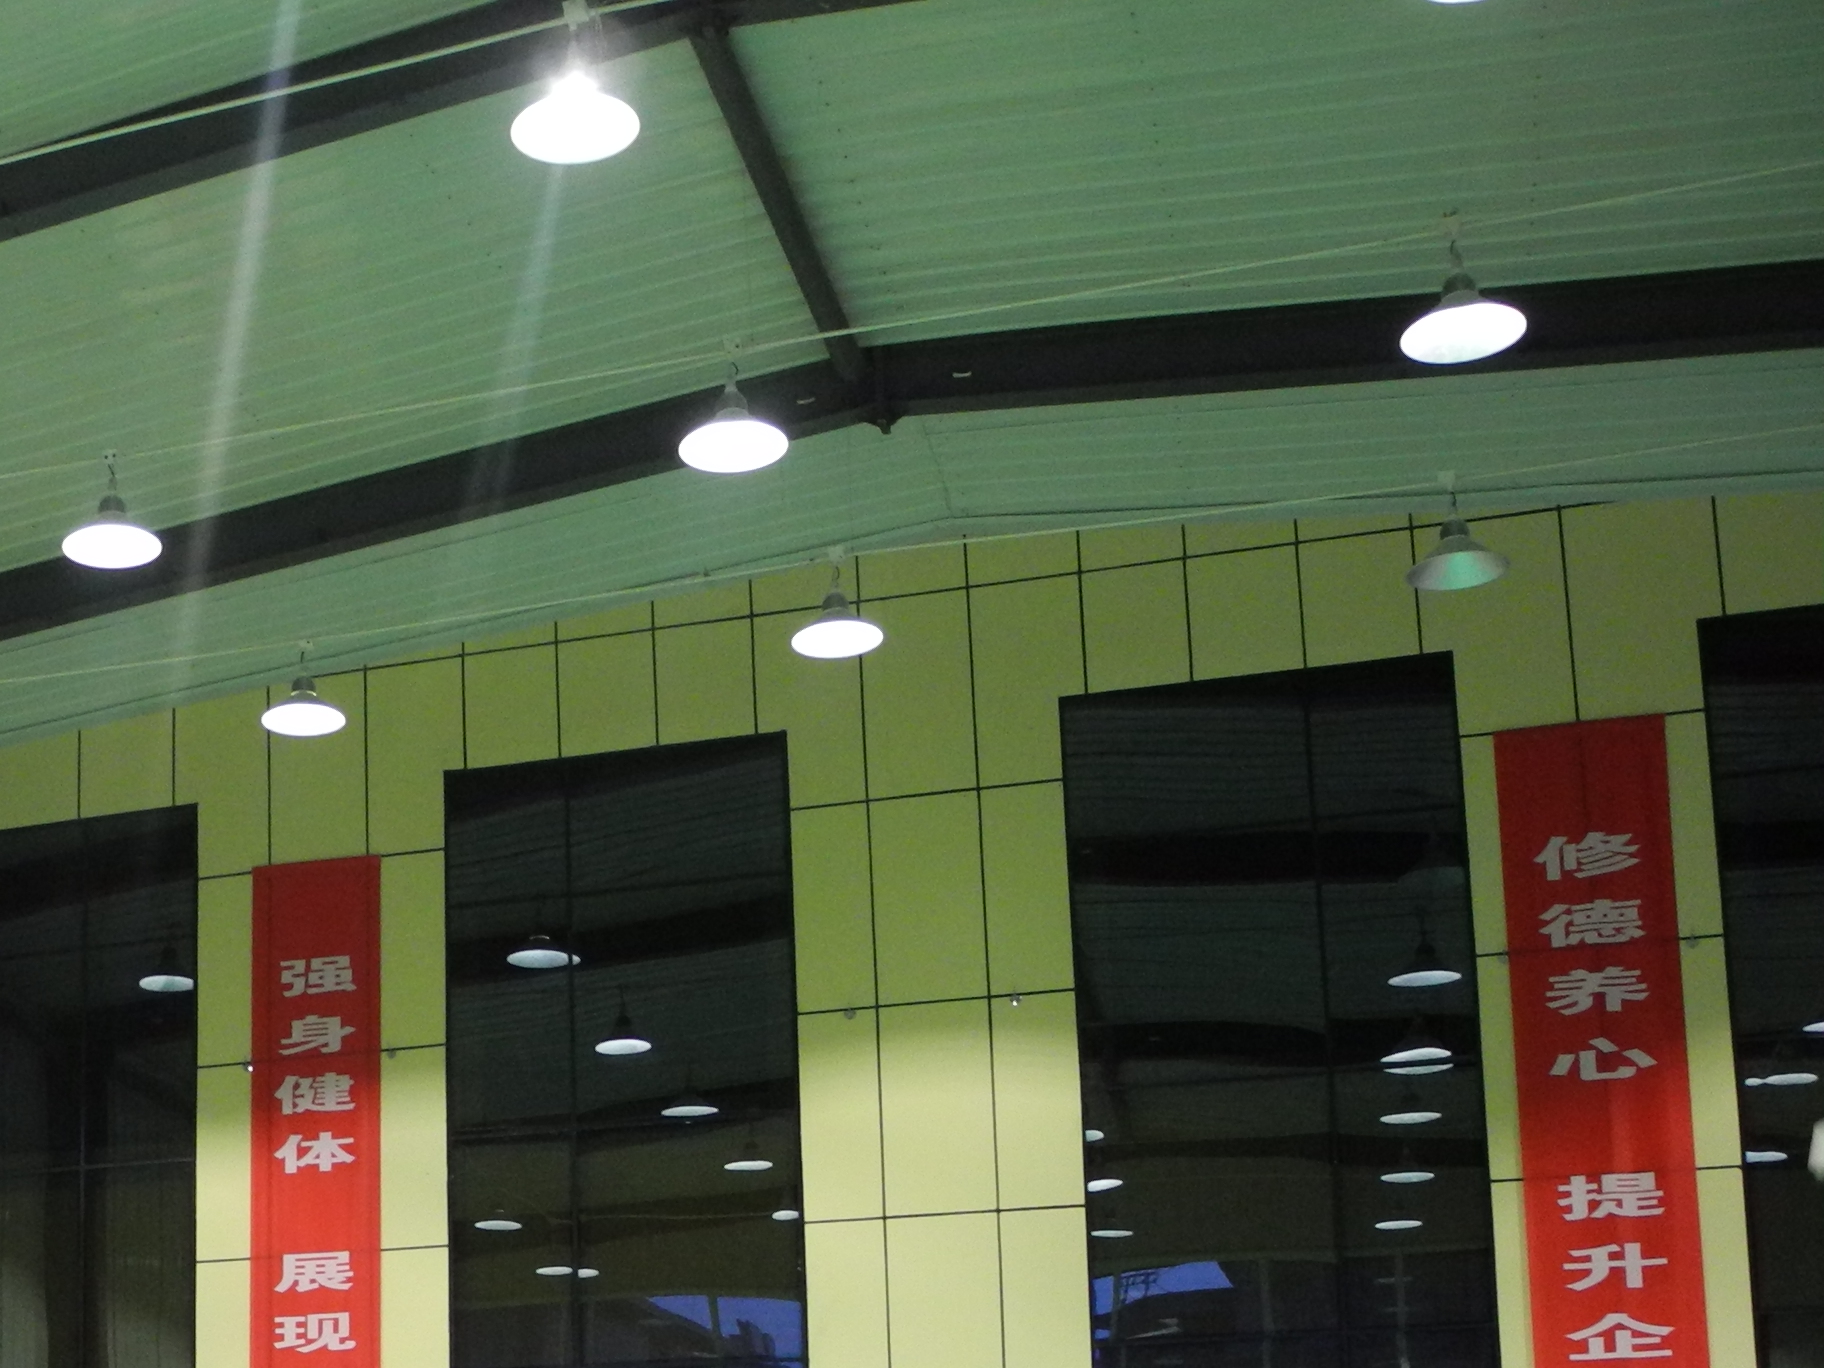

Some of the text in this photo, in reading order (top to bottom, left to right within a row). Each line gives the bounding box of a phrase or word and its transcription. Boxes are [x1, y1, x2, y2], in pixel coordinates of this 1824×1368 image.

[273, 955, 357, 1175] 强身健体
[1533, 831, 1658, 1081] 修德养心
